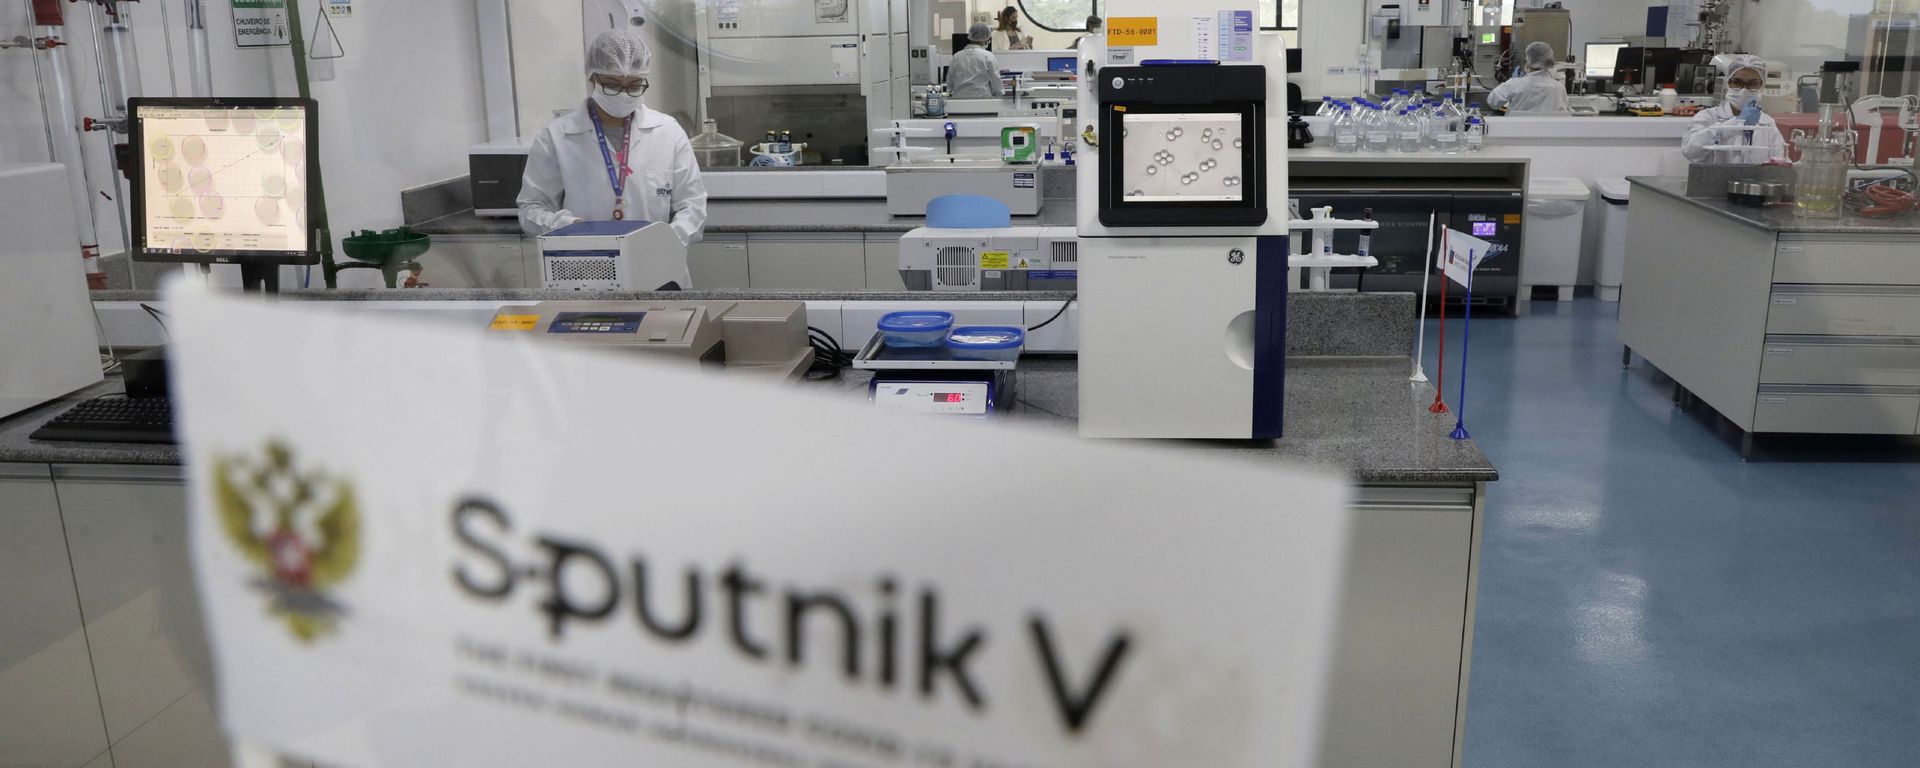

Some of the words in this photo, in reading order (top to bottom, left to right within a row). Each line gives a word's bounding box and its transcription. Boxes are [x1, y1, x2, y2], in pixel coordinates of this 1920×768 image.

[235, 17, 263, 25] CHUVEIRO
[237, 26, 272, 35] EMERGÊNCIA
[946, 393, 961, 403] 60
[450, 494, 988, 711] Sputnik
[1024, 606, 1132, 736] V
